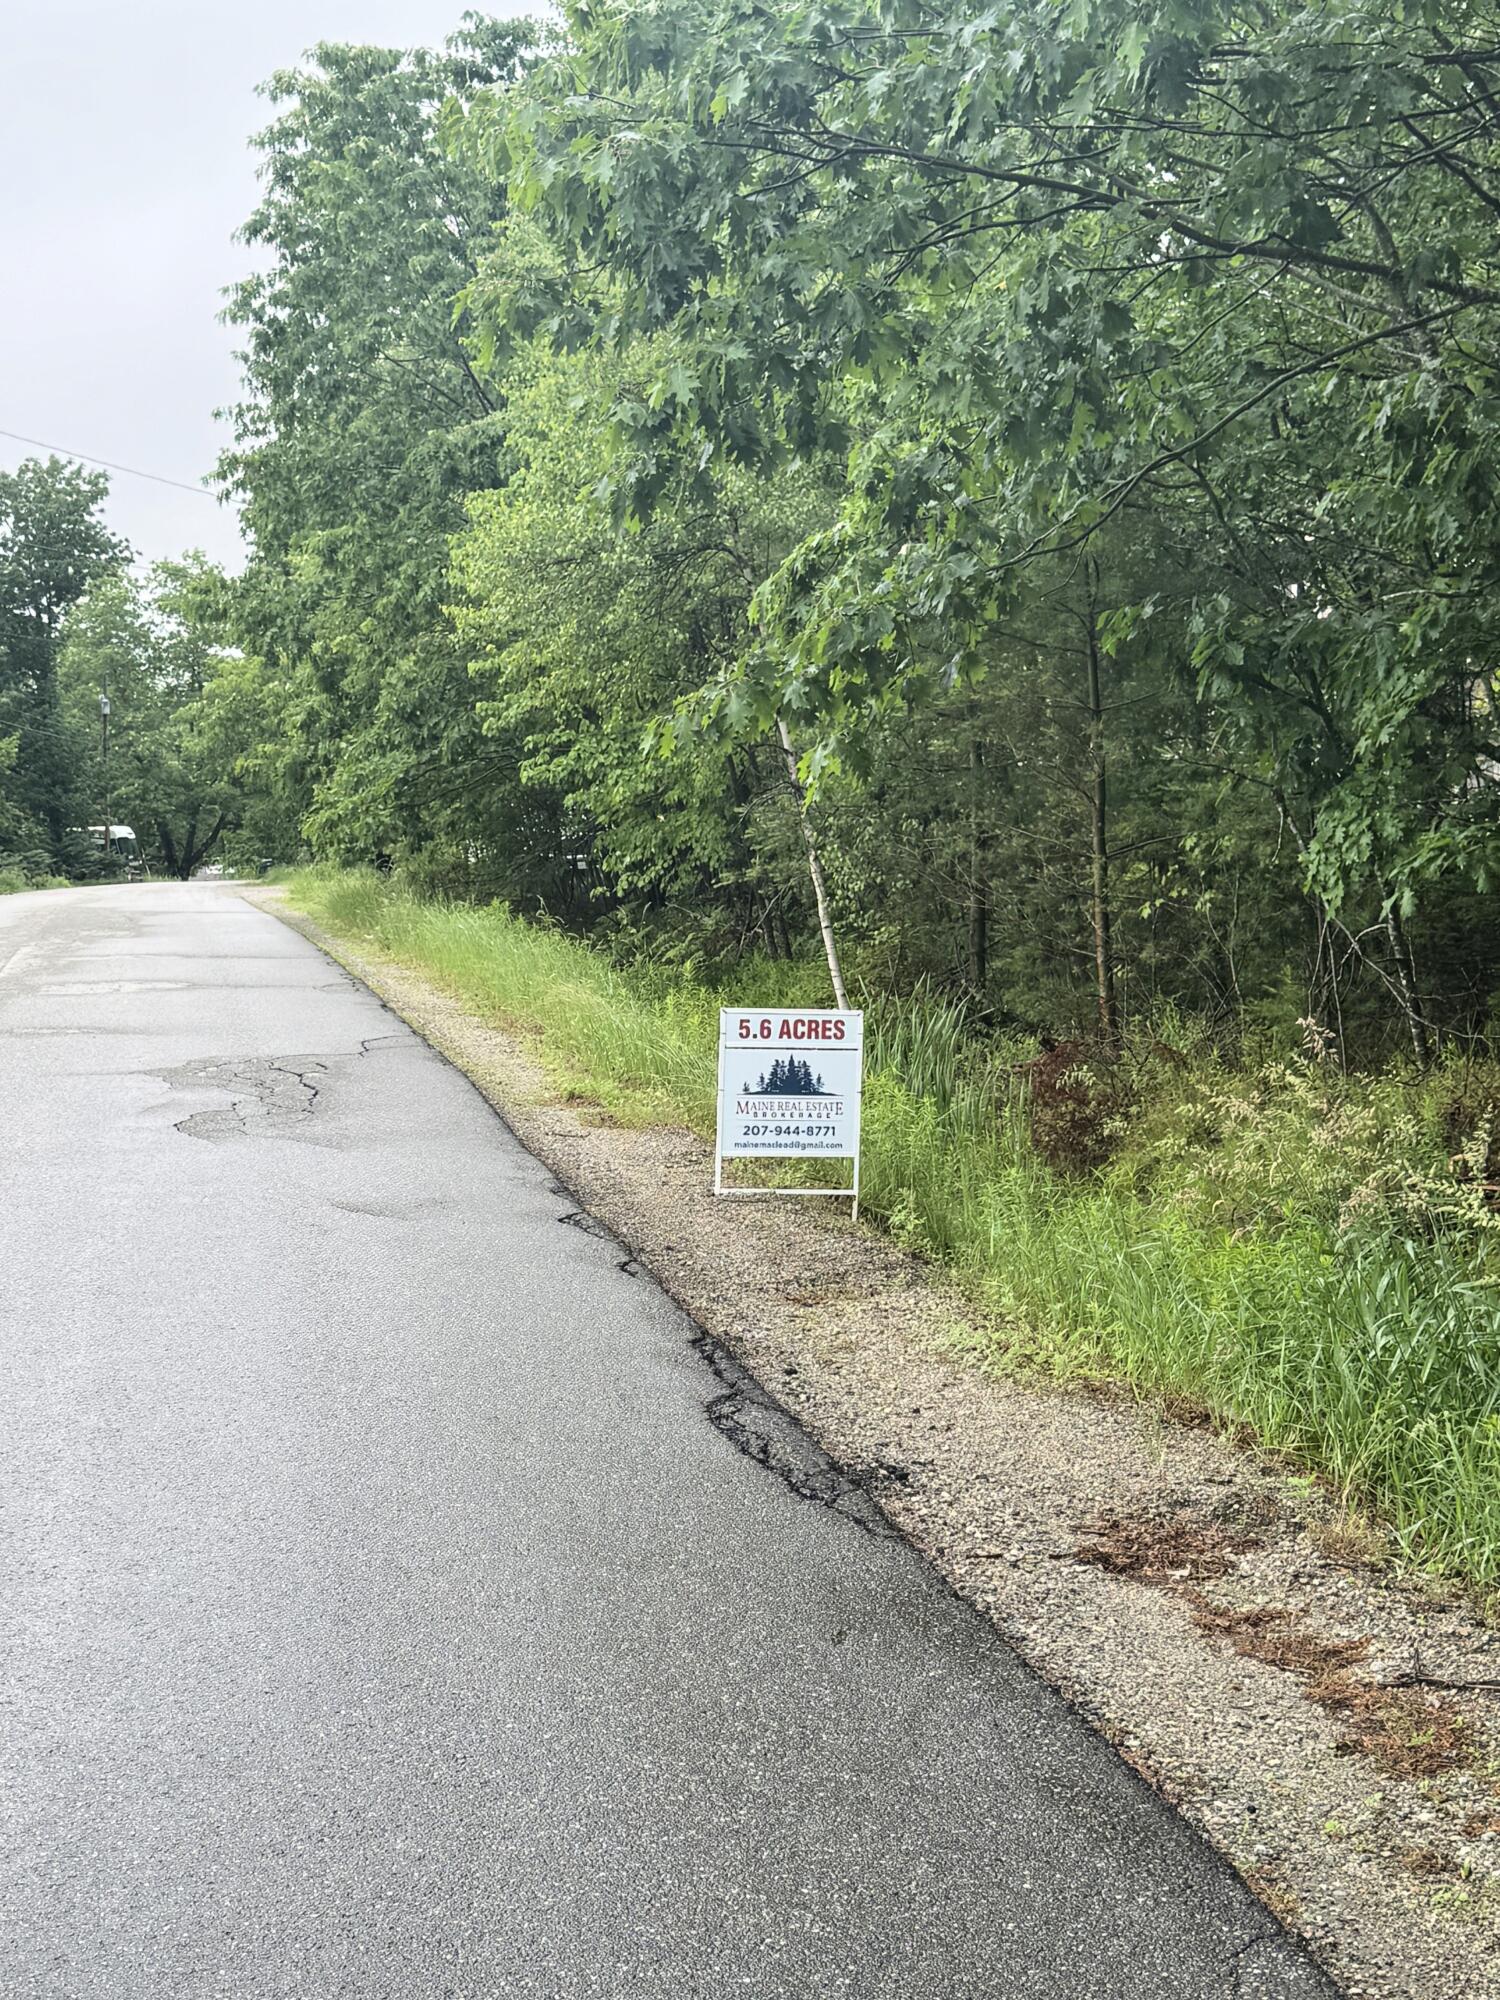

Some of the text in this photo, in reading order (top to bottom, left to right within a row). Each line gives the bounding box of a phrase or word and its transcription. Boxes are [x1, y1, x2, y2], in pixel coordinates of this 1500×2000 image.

[738, 1019, 846, 1040] 5.6 ACRES
[735, 1101, 844, 1116] MAINE REAL ESTATE
[753, 1111, 831, 1119] BROKERAGE
[743, 1125, 836, 1137] 207-944-8771
